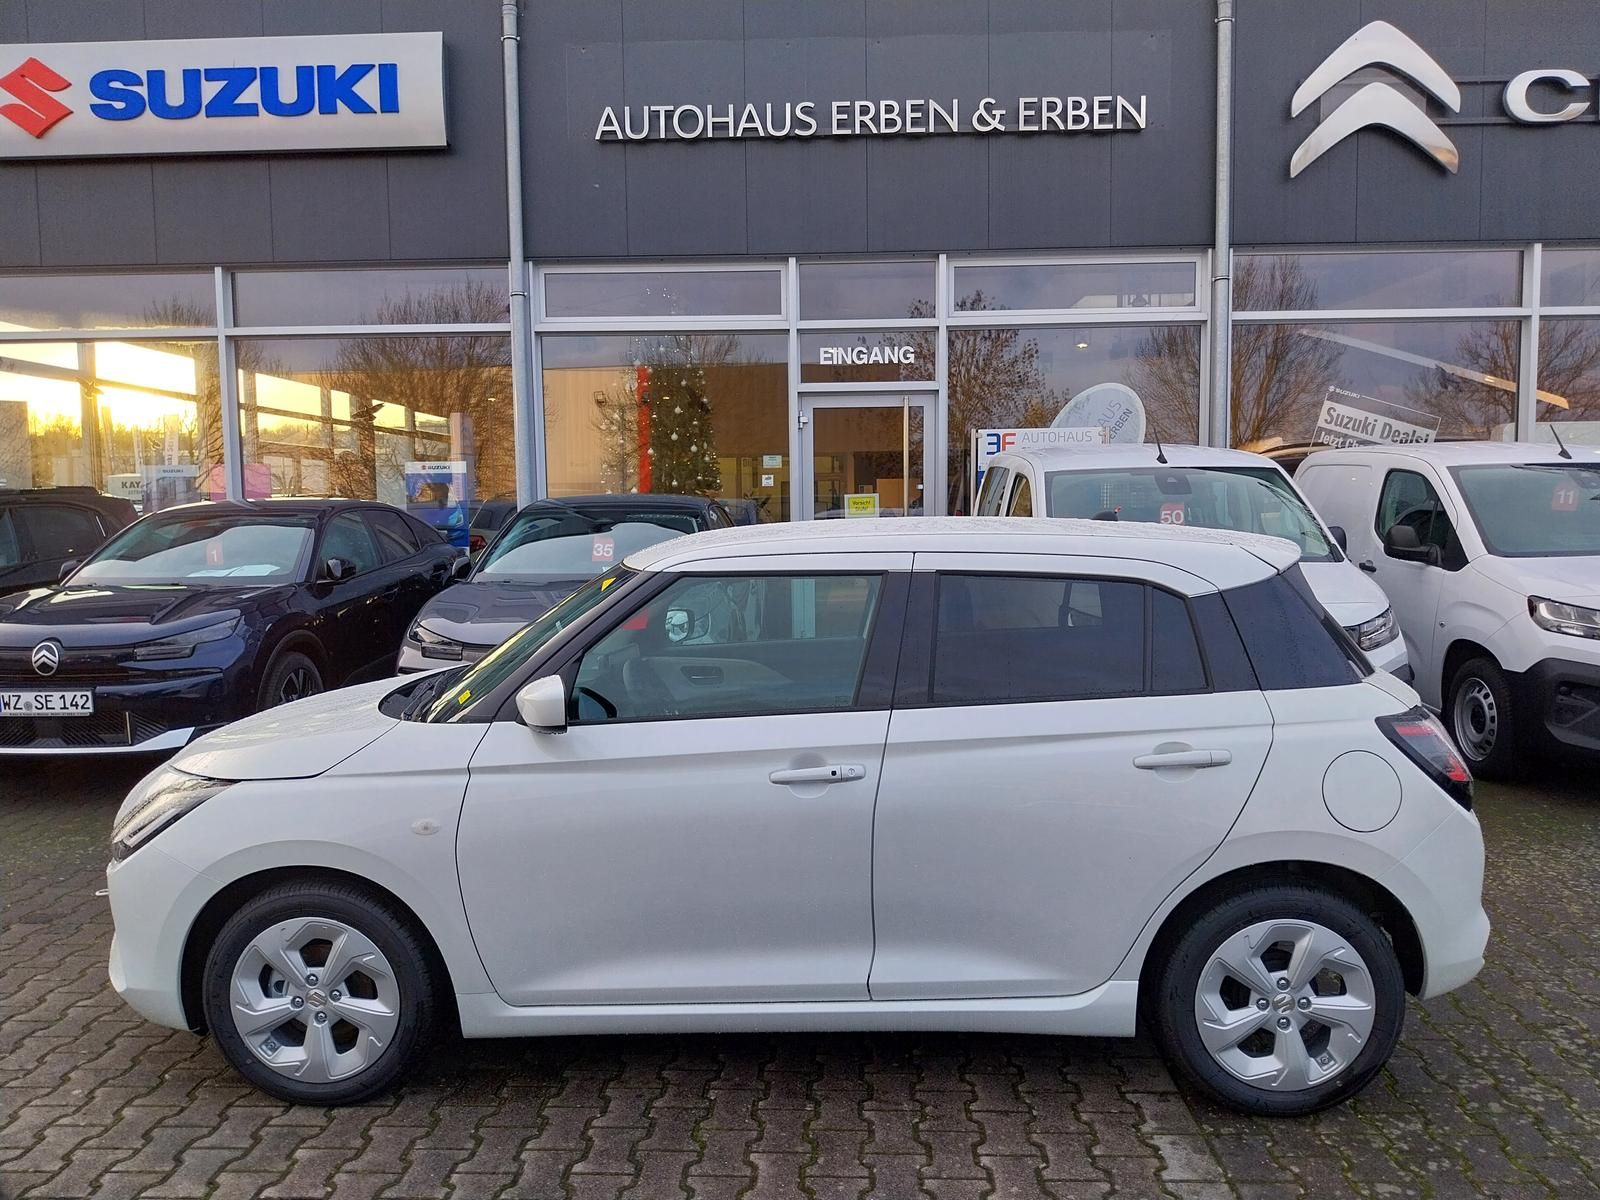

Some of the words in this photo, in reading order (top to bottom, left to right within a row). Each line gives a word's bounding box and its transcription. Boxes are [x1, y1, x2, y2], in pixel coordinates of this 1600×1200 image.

[89, 63, 400, 121] SUZUKI
[595, 102, 817, 141] AUTOHAUS
[831, 98, 959, 135] ERBEN
[972, 97, 1005, 132] &
[1018, 95, 1147, 131] ERBEN
[820, 346, 915, 365] EINGANG
[1335, 388, 1360, 399] SUZUKI
[1324, 406, 1378, 437] Suzuki
[1022, 431, 1092, 443] AUTOHAUS
[1557, 489, 1574, 505] 11
[1160, 510, 1184, 524] 50
[211, 549, 217, 562] 1
[593, 543, 613, 557] 35
[2, 695, 23, 710] WZ
[34, 694, 55, 710] SE
[59, 694, 90, 710] 142
